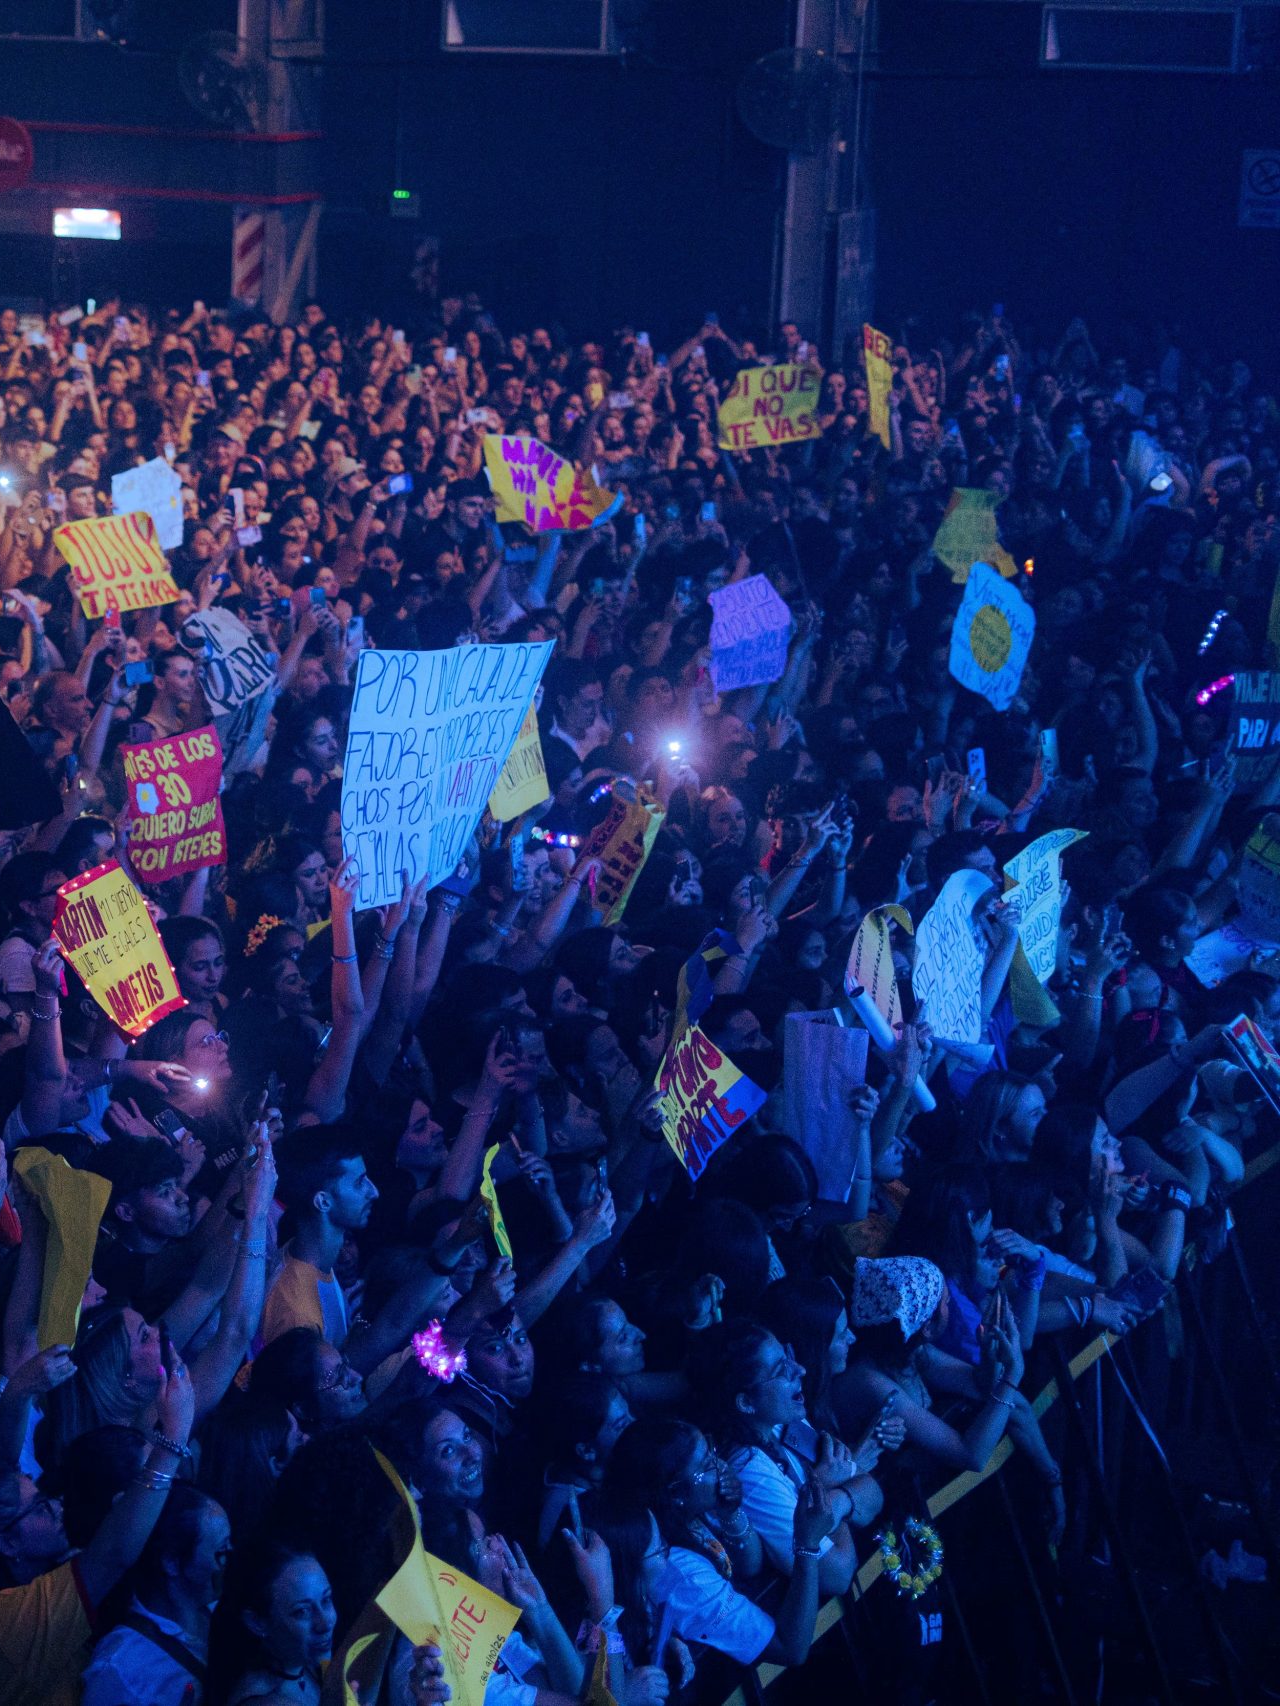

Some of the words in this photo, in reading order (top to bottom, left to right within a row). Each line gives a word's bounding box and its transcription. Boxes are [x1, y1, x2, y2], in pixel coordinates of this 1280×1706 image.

[761, 368, 817, 393] QUE
[754, 395, 783, 417] NO
[728, 421, 757, 446] TE
[764, 413, 812, 440] VAS
[354, 650, 420, 718] POR
[154, 743, 180, 770] DE
[179, 733, 216, 763] LOS
[344, 727, 441, 784] FAJORES
[156, 772, 191, 807] 30
[130, 809, 186, 841] QUIERO
[341, 787, 390, 831] CHOS
[130, 845, 169, 871] CON
